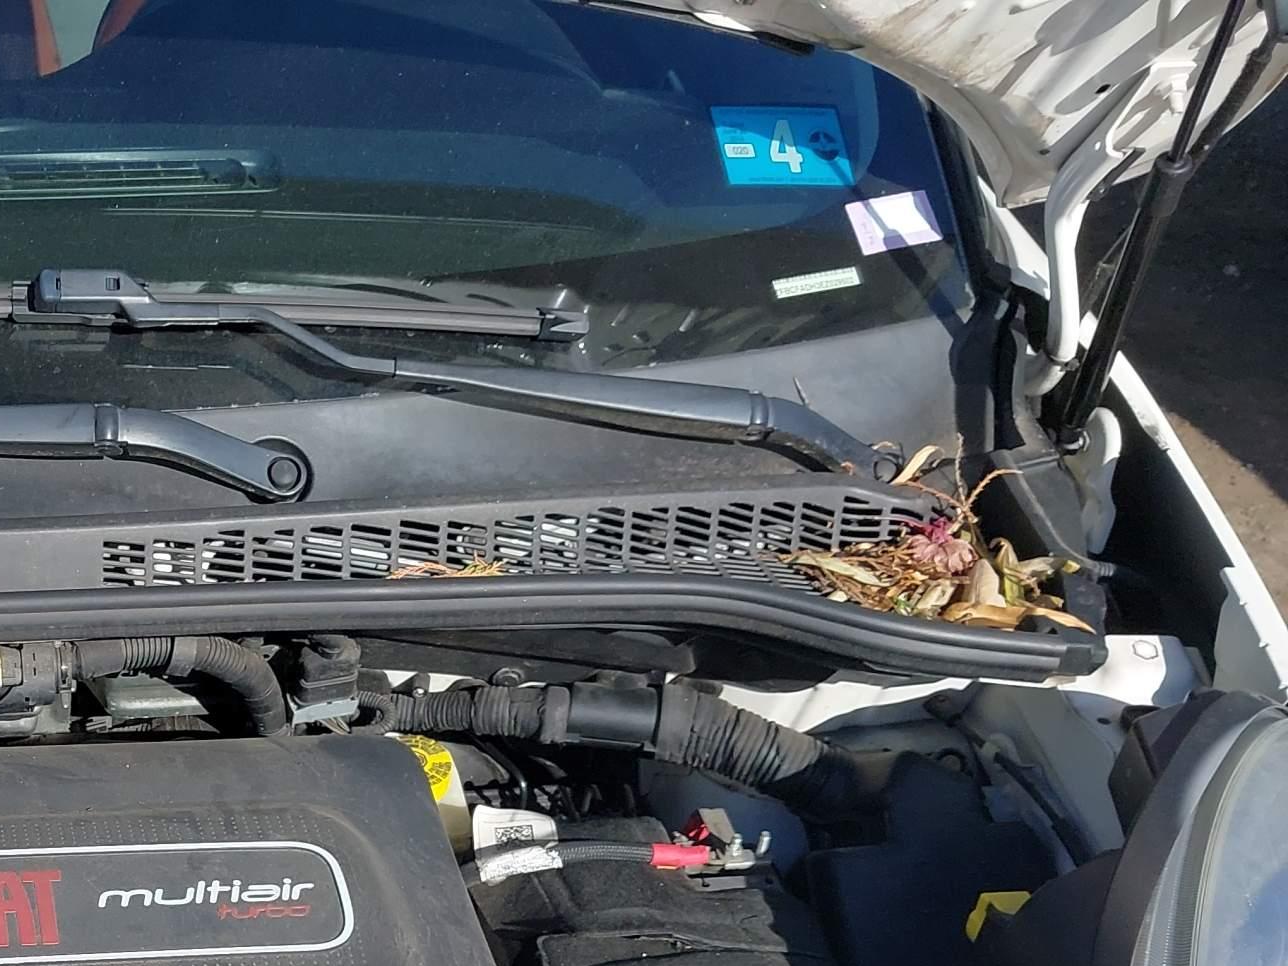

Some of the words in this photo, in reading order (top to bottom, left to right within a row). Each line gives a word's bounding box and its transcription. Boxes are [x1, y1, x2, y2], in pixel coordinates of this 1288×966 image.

[770, 119, 803, 173] 4
[98, 878, 315, 908] multiair
[217, 904, 312, 920] turbo
